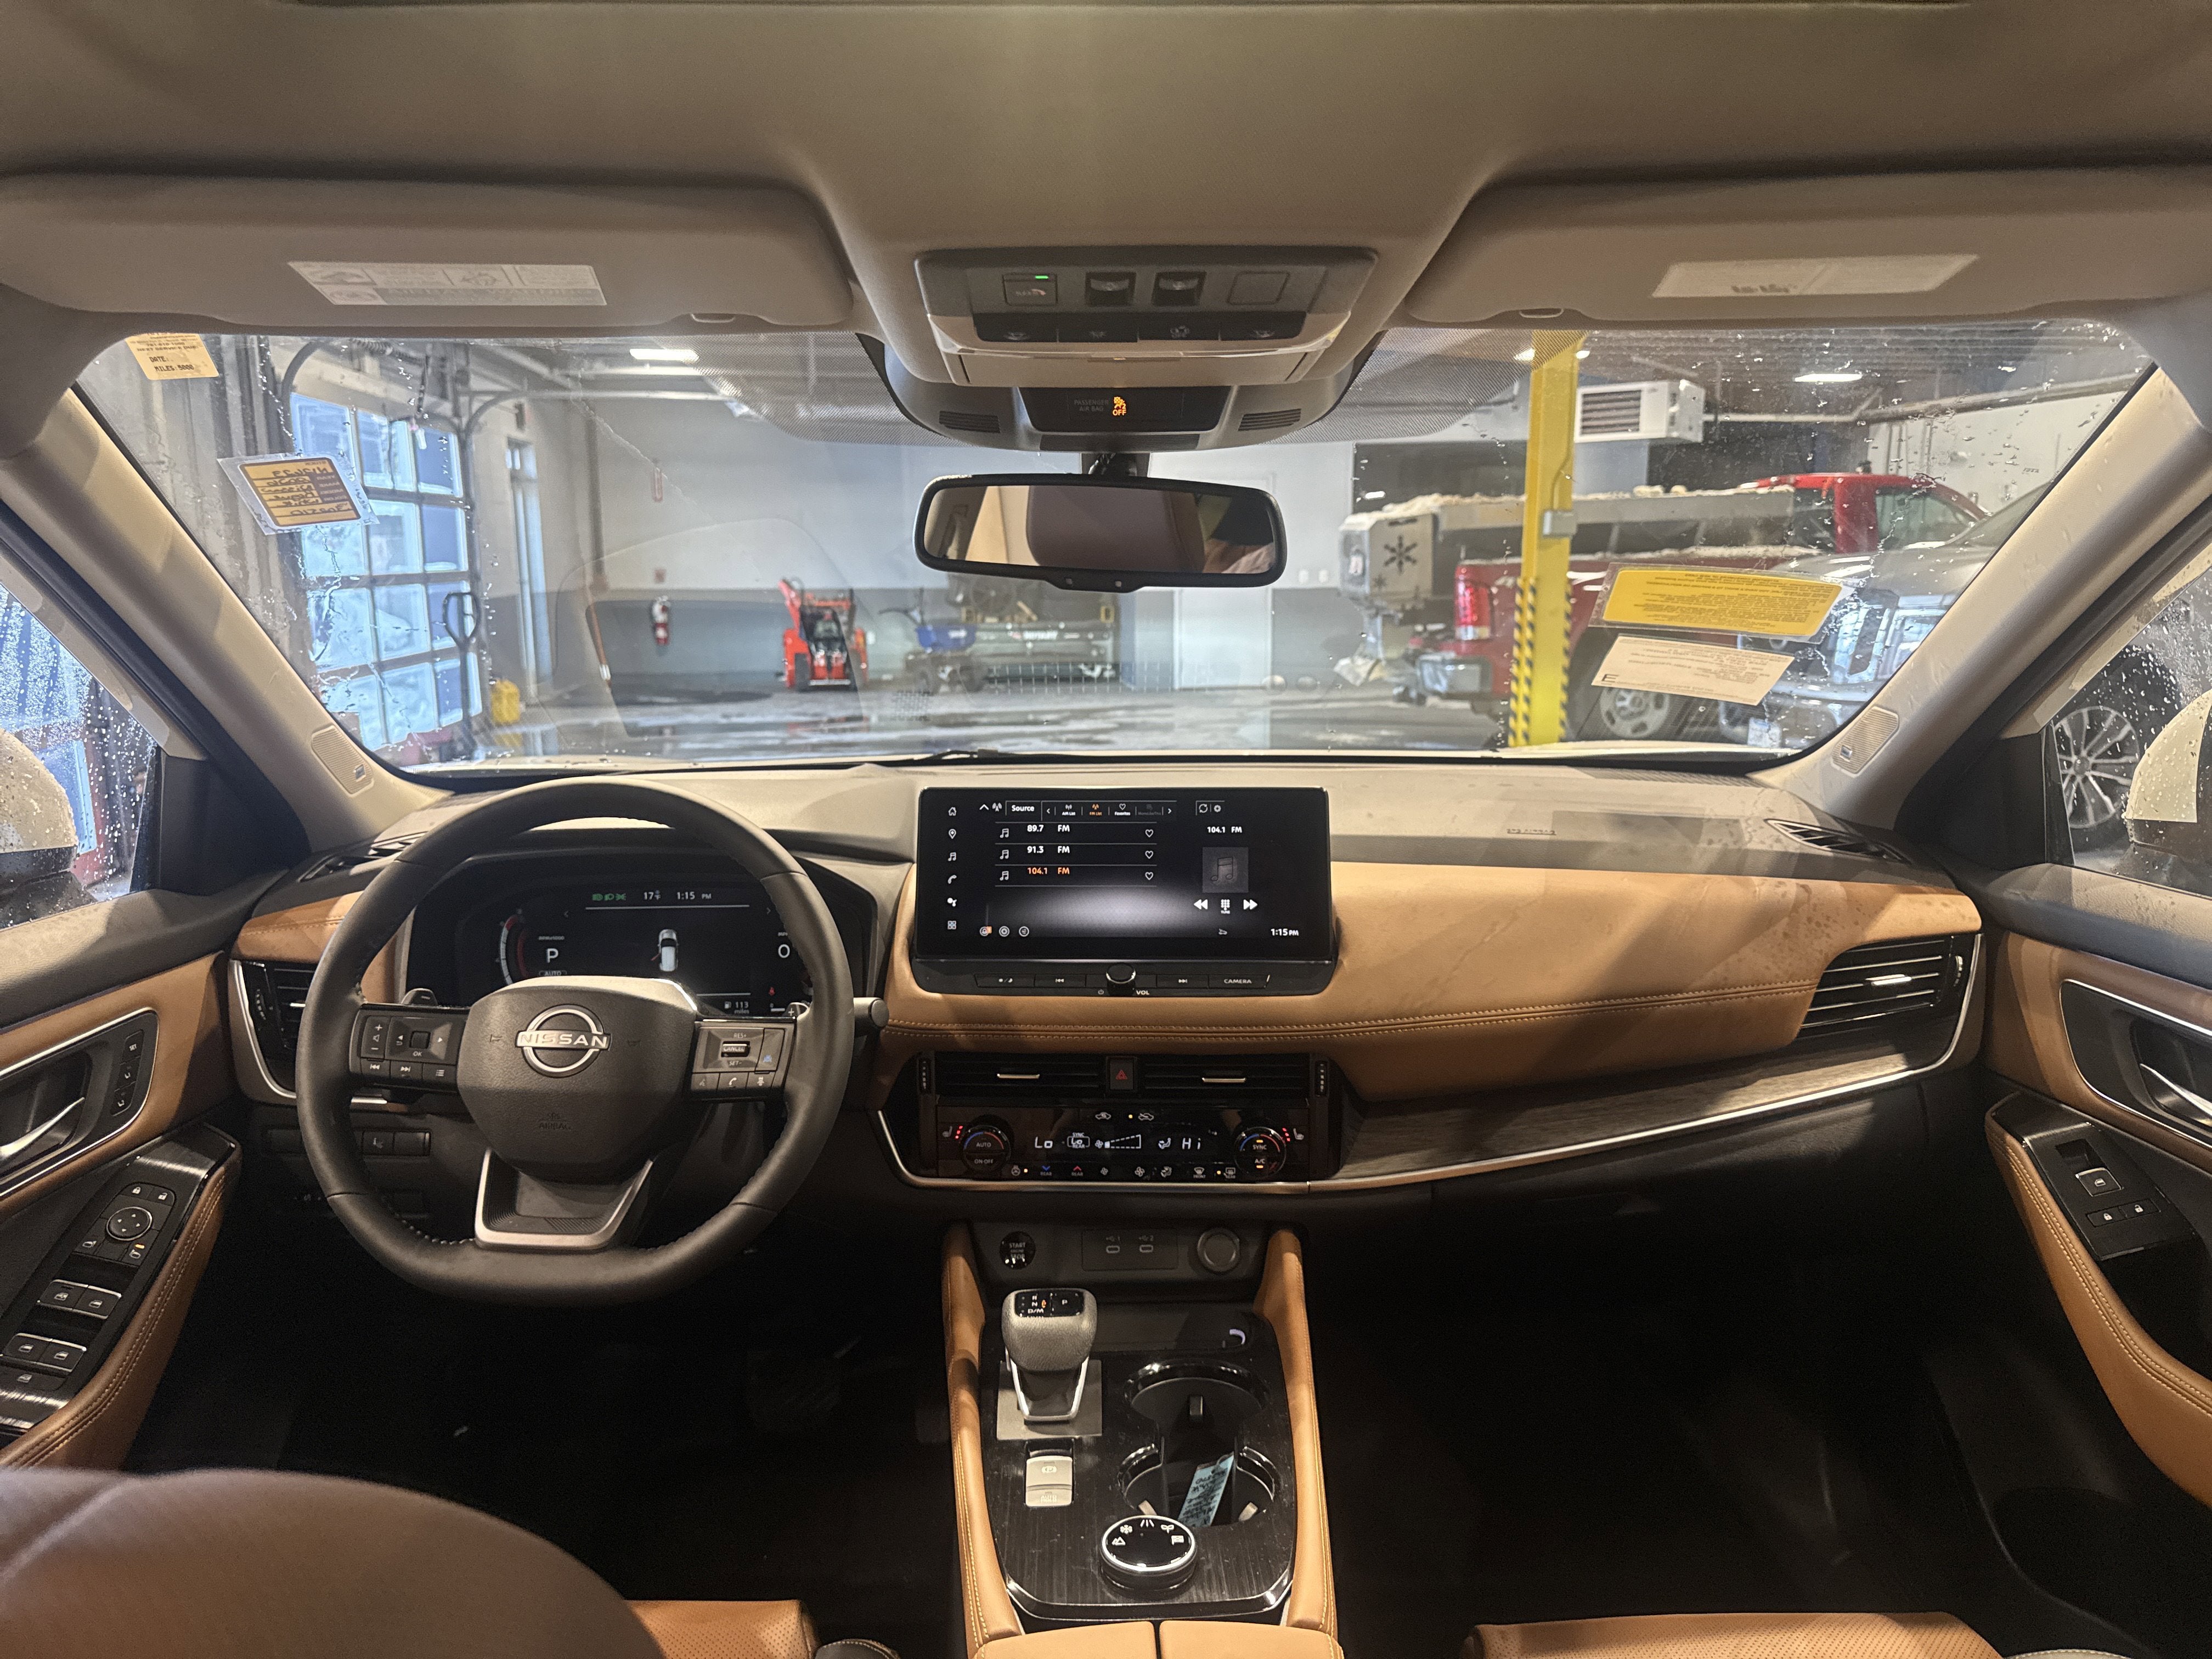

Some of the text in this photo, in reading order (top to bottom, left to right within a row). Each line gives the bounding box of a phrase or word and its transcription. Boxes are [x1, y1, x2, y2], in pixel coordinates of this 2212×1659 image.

[677, 891, 695, 900] 1:15
[546, 948, 559, 963] P
[778, 944, 791, 958] 0
[521, 1033, 607, 1048] NISSAN
[1034, 1136, 1053, 1148] Lo
